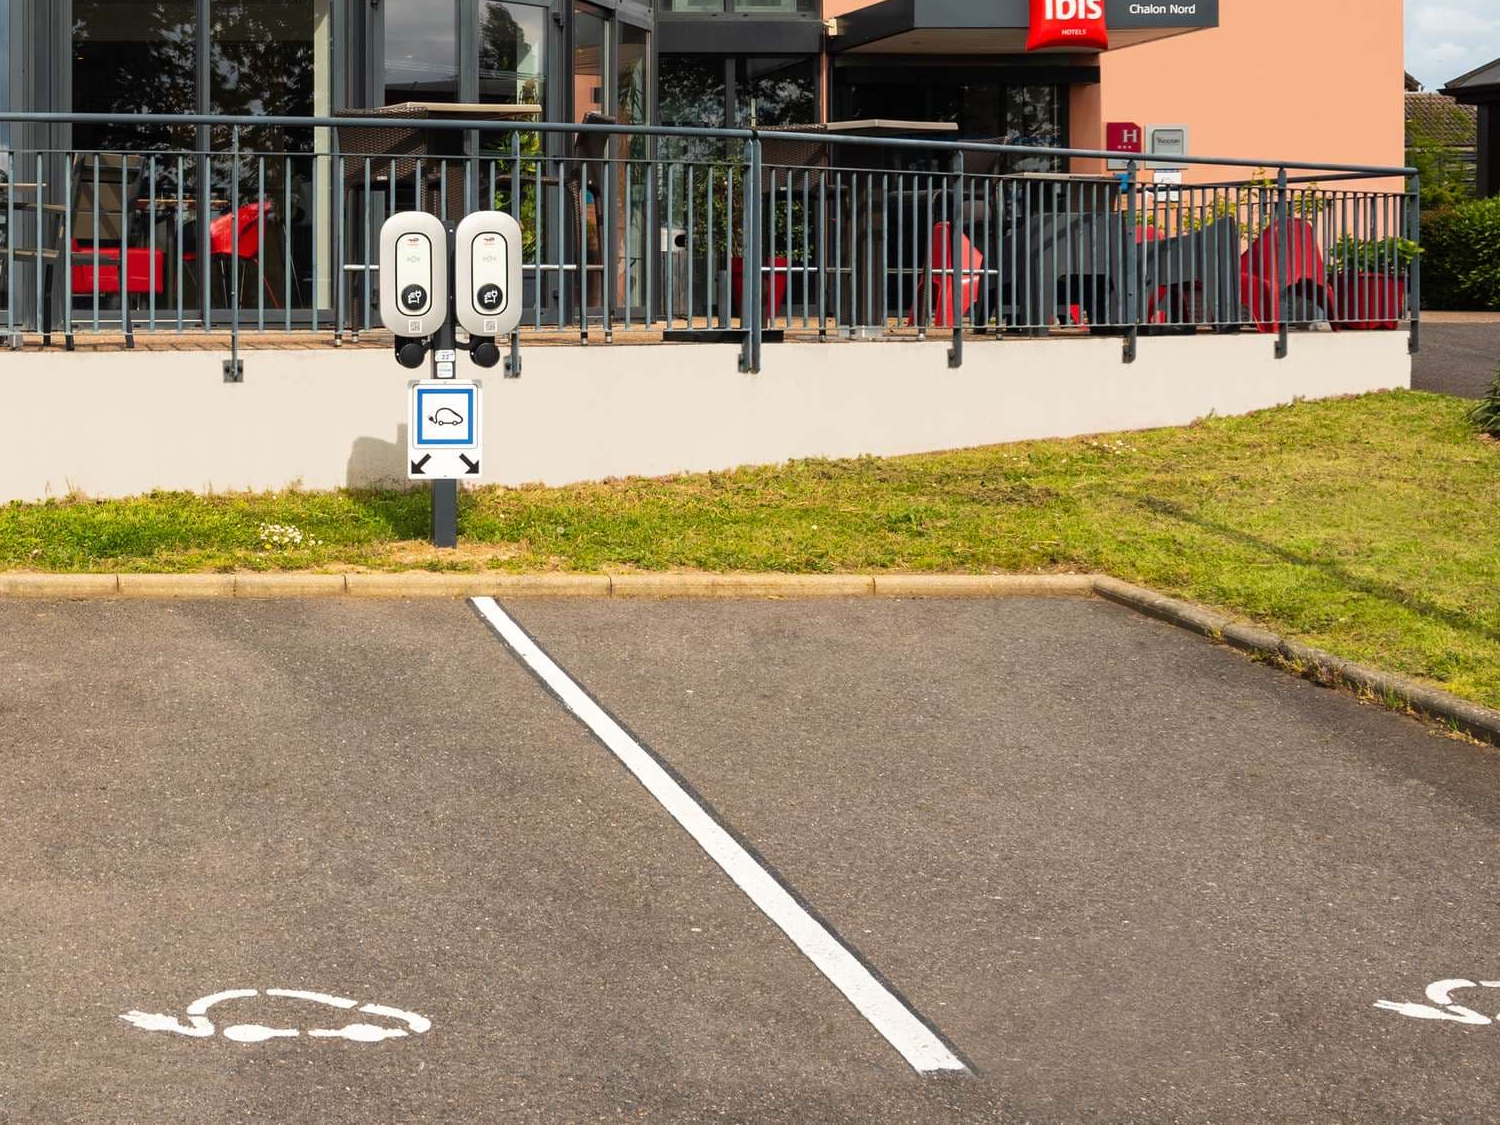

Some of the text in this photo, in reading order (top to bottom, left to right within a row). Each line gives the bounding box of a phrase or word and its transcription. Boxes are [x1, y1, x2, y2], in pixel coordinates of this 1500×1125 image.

[1129, 3, 1196, 14] Chalon Nord
[1061, 28, 1087, 36] HOTELS
[1123, 129, 1138, 143] H
